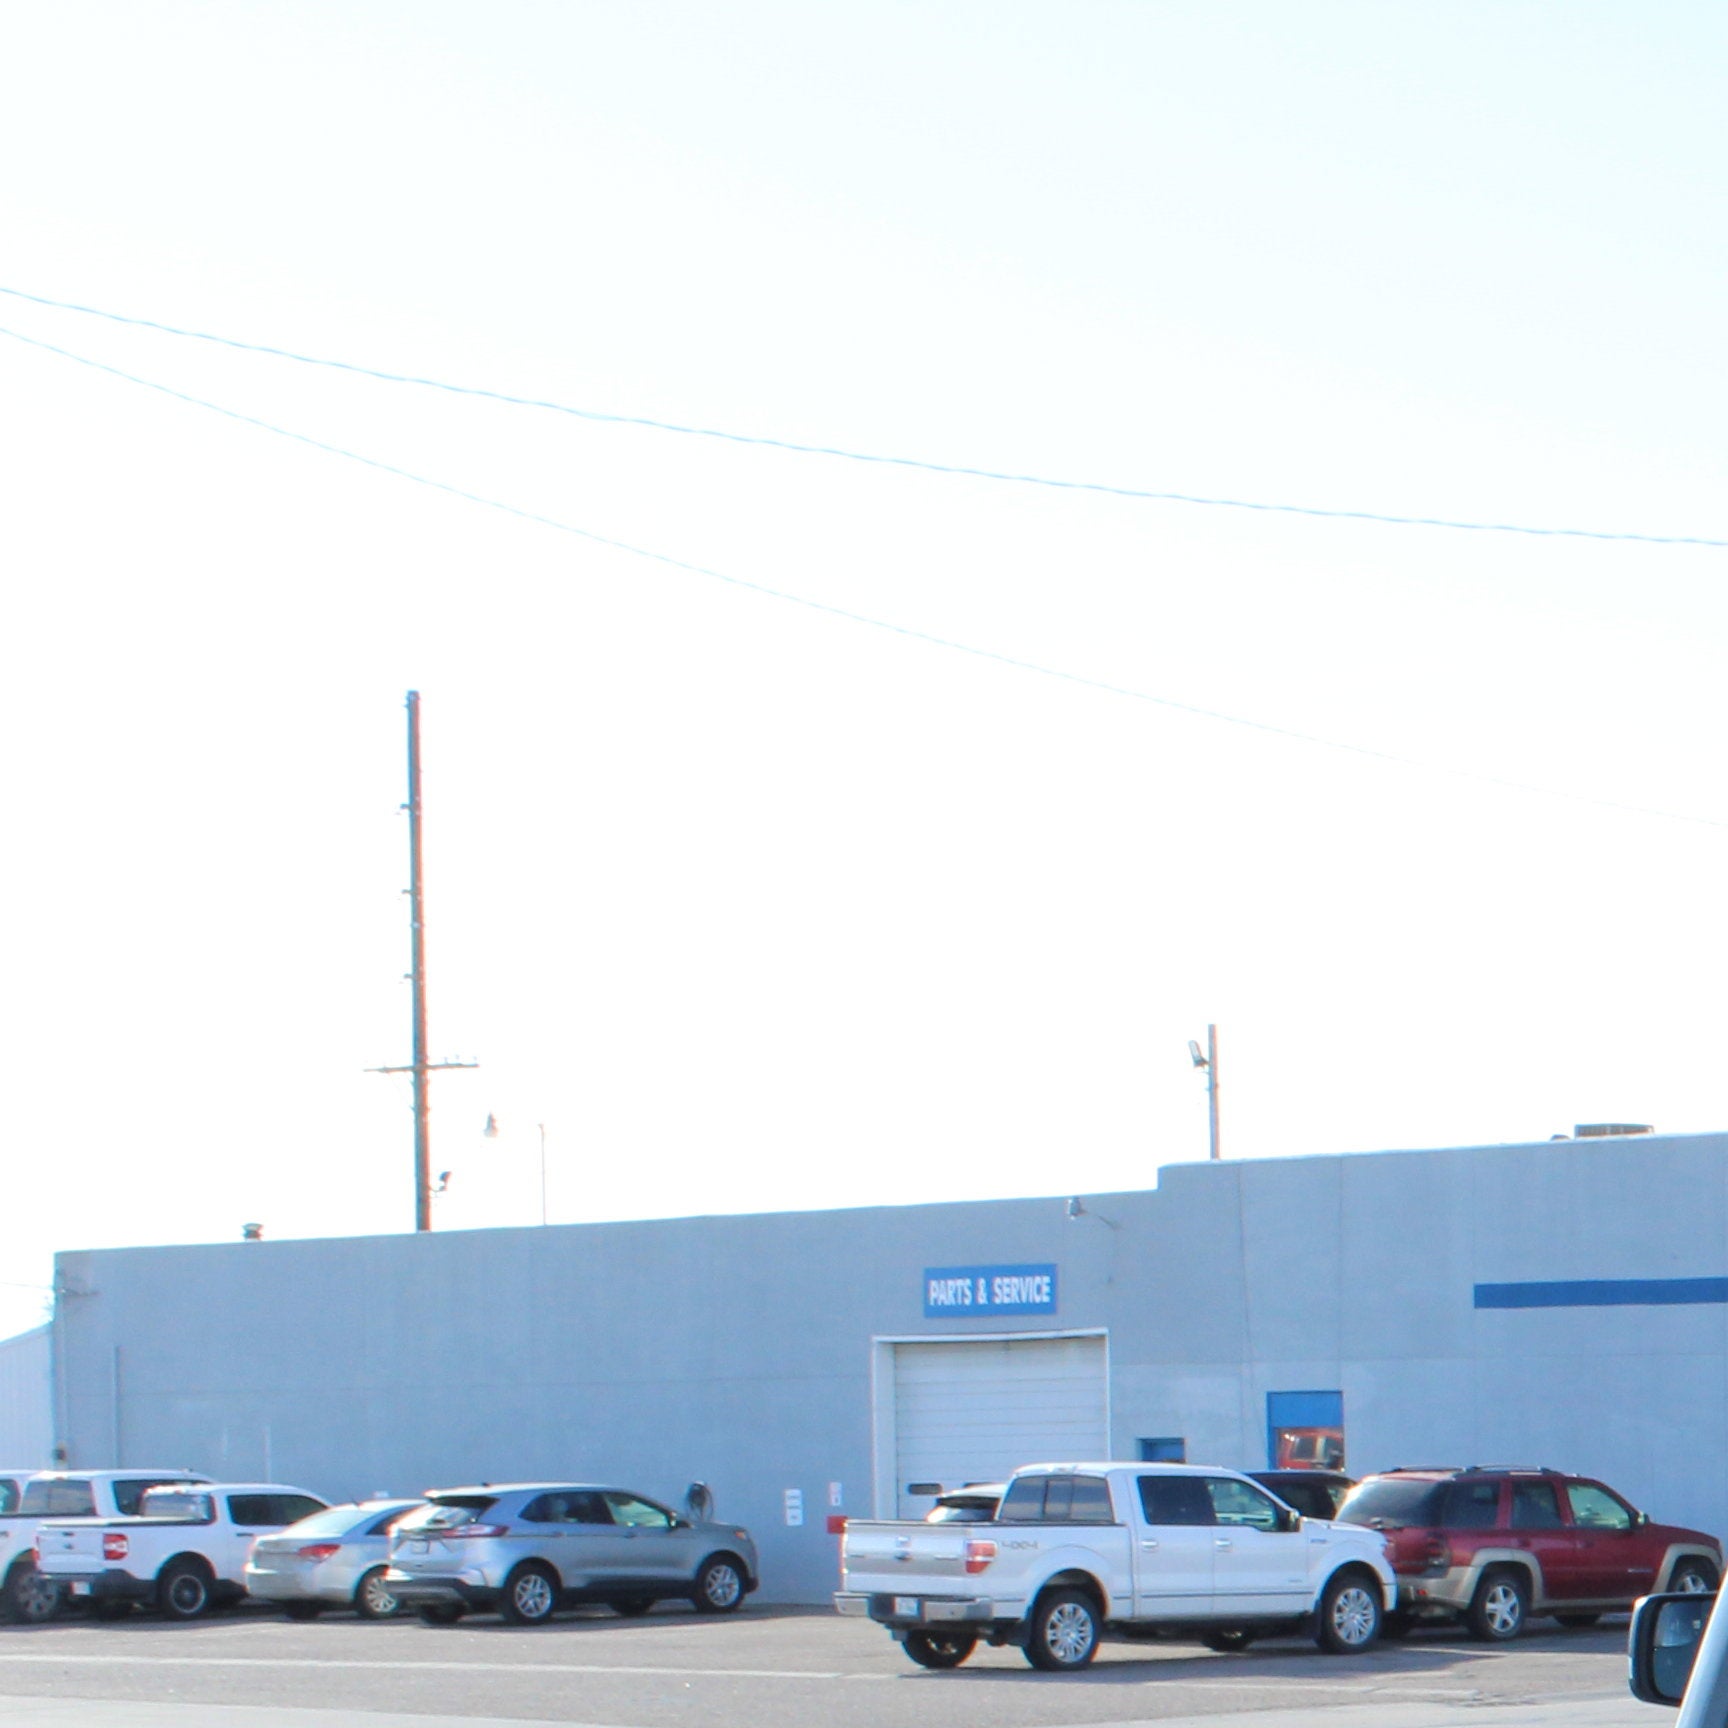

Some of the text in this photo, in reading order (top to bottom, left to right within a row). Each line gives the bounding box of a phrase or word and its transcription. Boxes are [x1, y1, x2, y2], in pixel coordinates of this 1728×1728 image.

[928, 1275, 1051, 1306] PARTS & SERVICE
